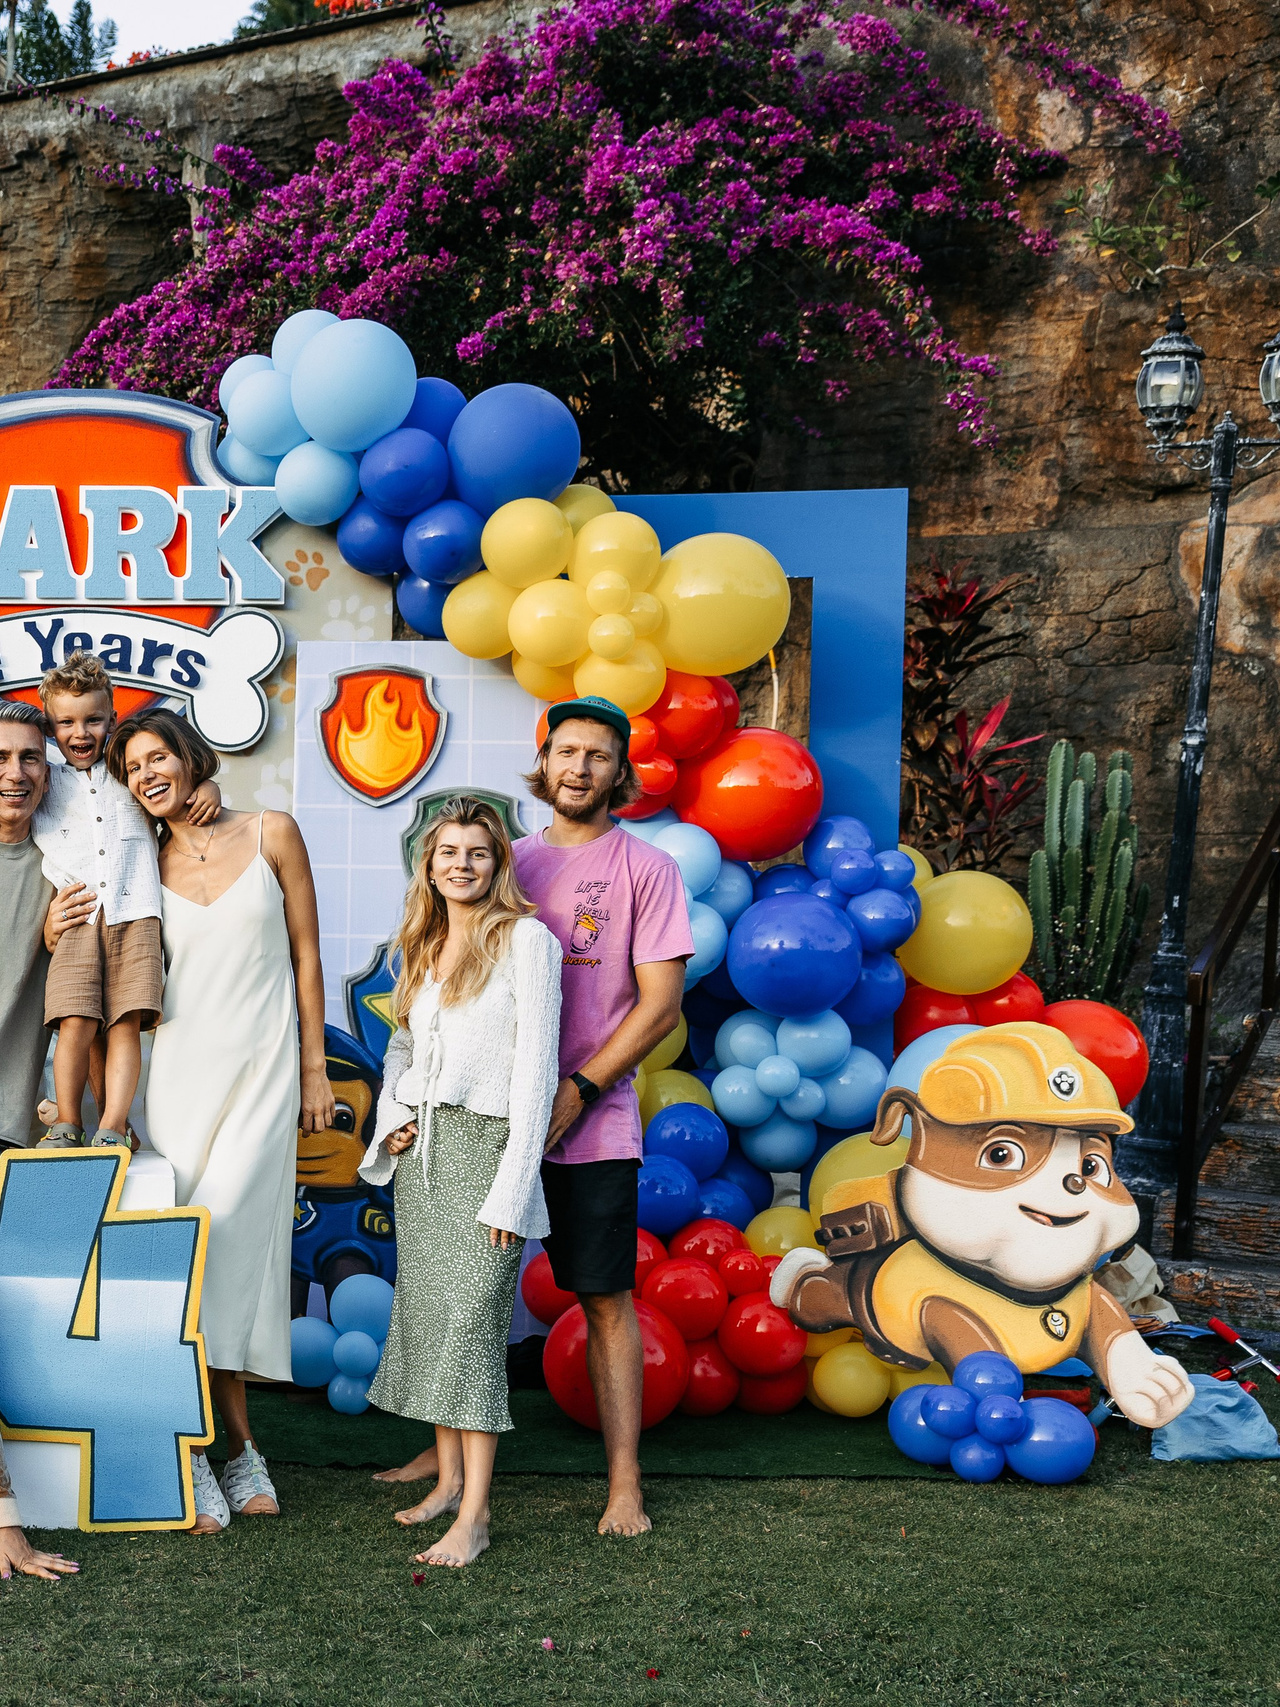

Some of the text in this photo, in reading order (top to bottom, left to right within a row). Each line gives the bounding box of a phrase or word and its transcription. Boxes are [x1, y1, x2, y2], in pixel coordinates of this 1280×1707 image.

[23, 618, 207, 689] Years
[574, 880, 611, 893] LIFE
[586, 893, 601, 906] IS
[574, 902, 610, 920] SWELL
